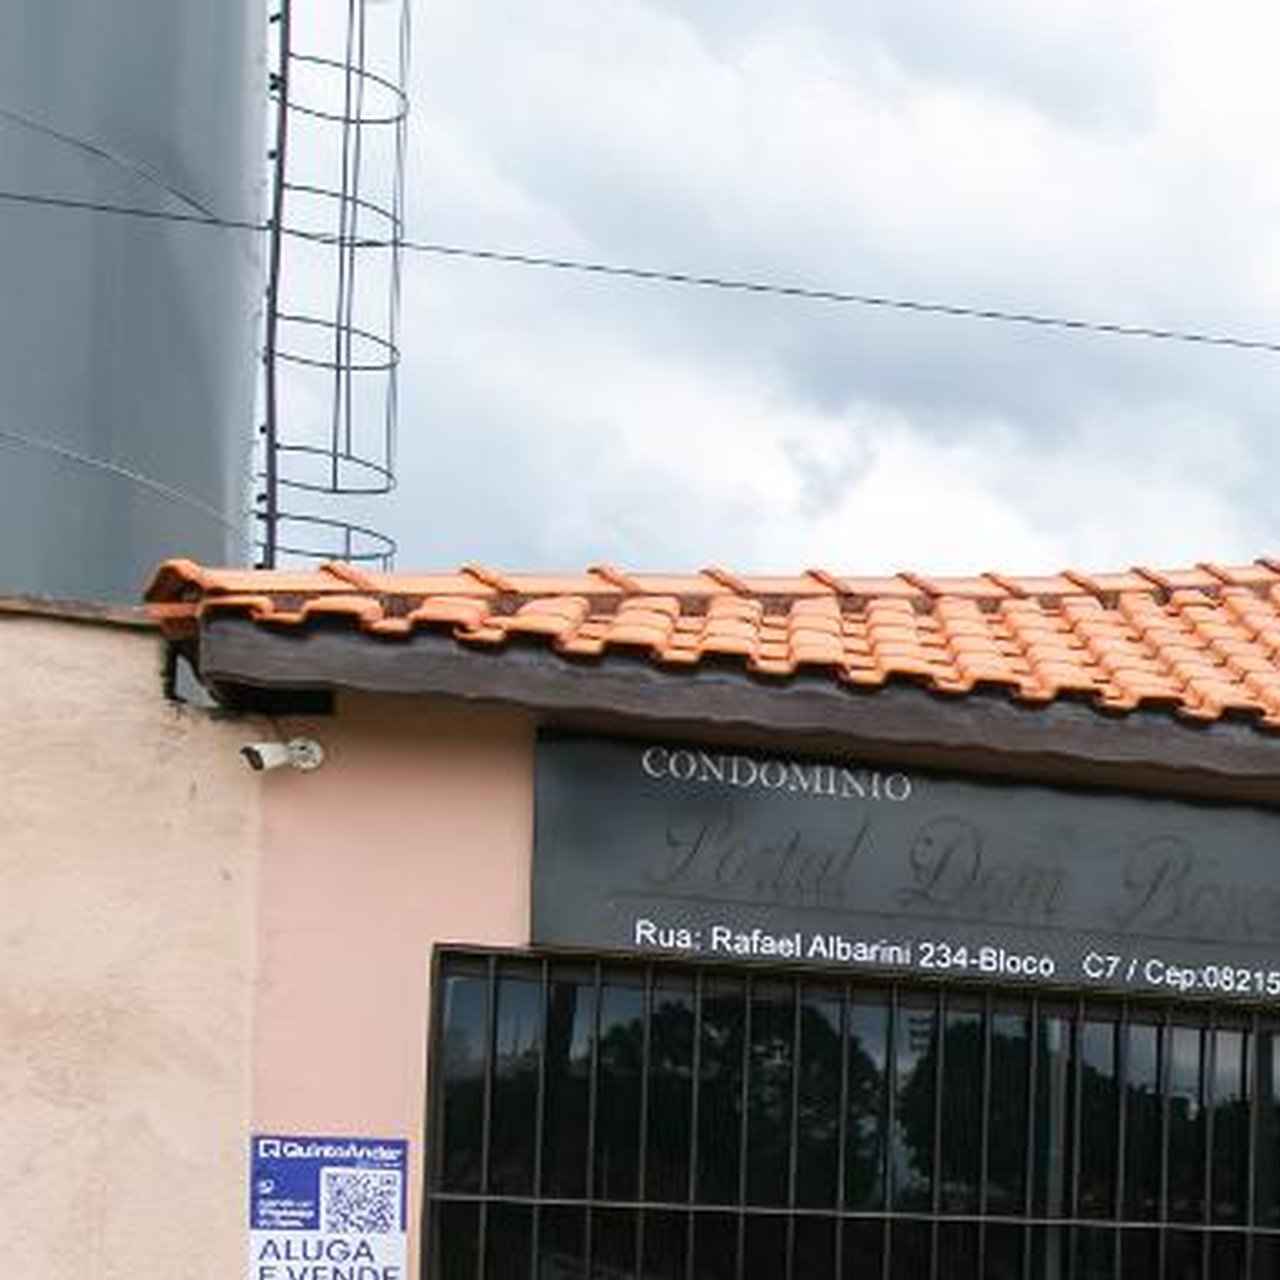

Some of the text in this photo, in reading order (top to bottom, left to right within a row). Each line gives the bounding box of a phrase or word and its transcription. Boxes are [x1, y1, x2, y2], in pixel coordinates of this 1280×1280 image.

[642, 747, 911, 801] CONDOMINIO
[635, 919, 701, 949] Rua:
[712, 926, 801, 958] Rafael
[1083, 952, 1121, 979] C7
[258, 1238, 375, 1262] ALUGA
